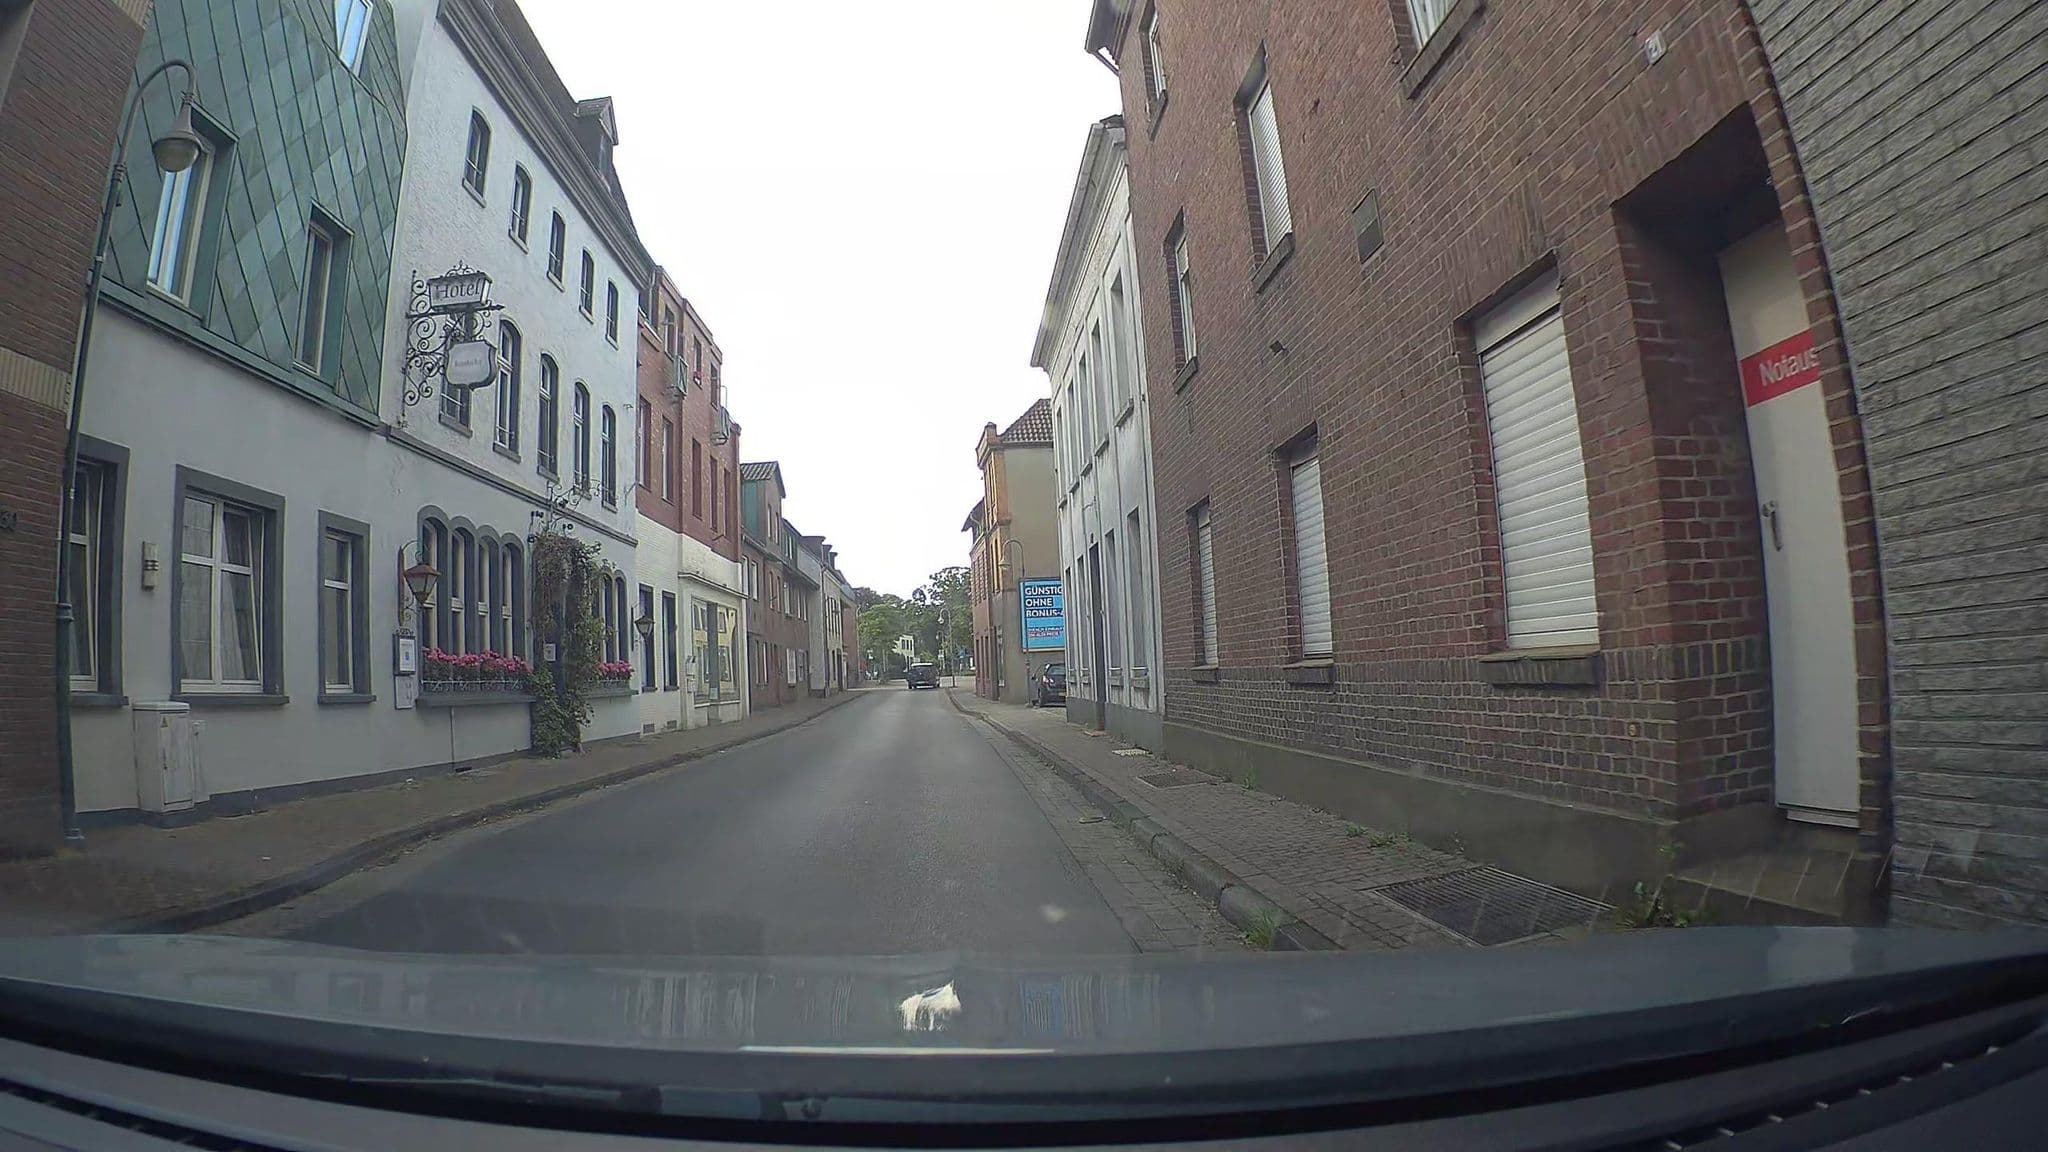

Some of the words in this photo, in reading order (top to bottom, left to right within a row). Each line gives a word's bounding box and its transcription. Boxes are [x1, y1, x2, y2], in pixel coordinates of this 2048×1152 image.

[433, 278, 481, 300] Hotel
[1759, 347, 1820, 387] Notaus
[1025, 597, 1053, 607] OHNE
